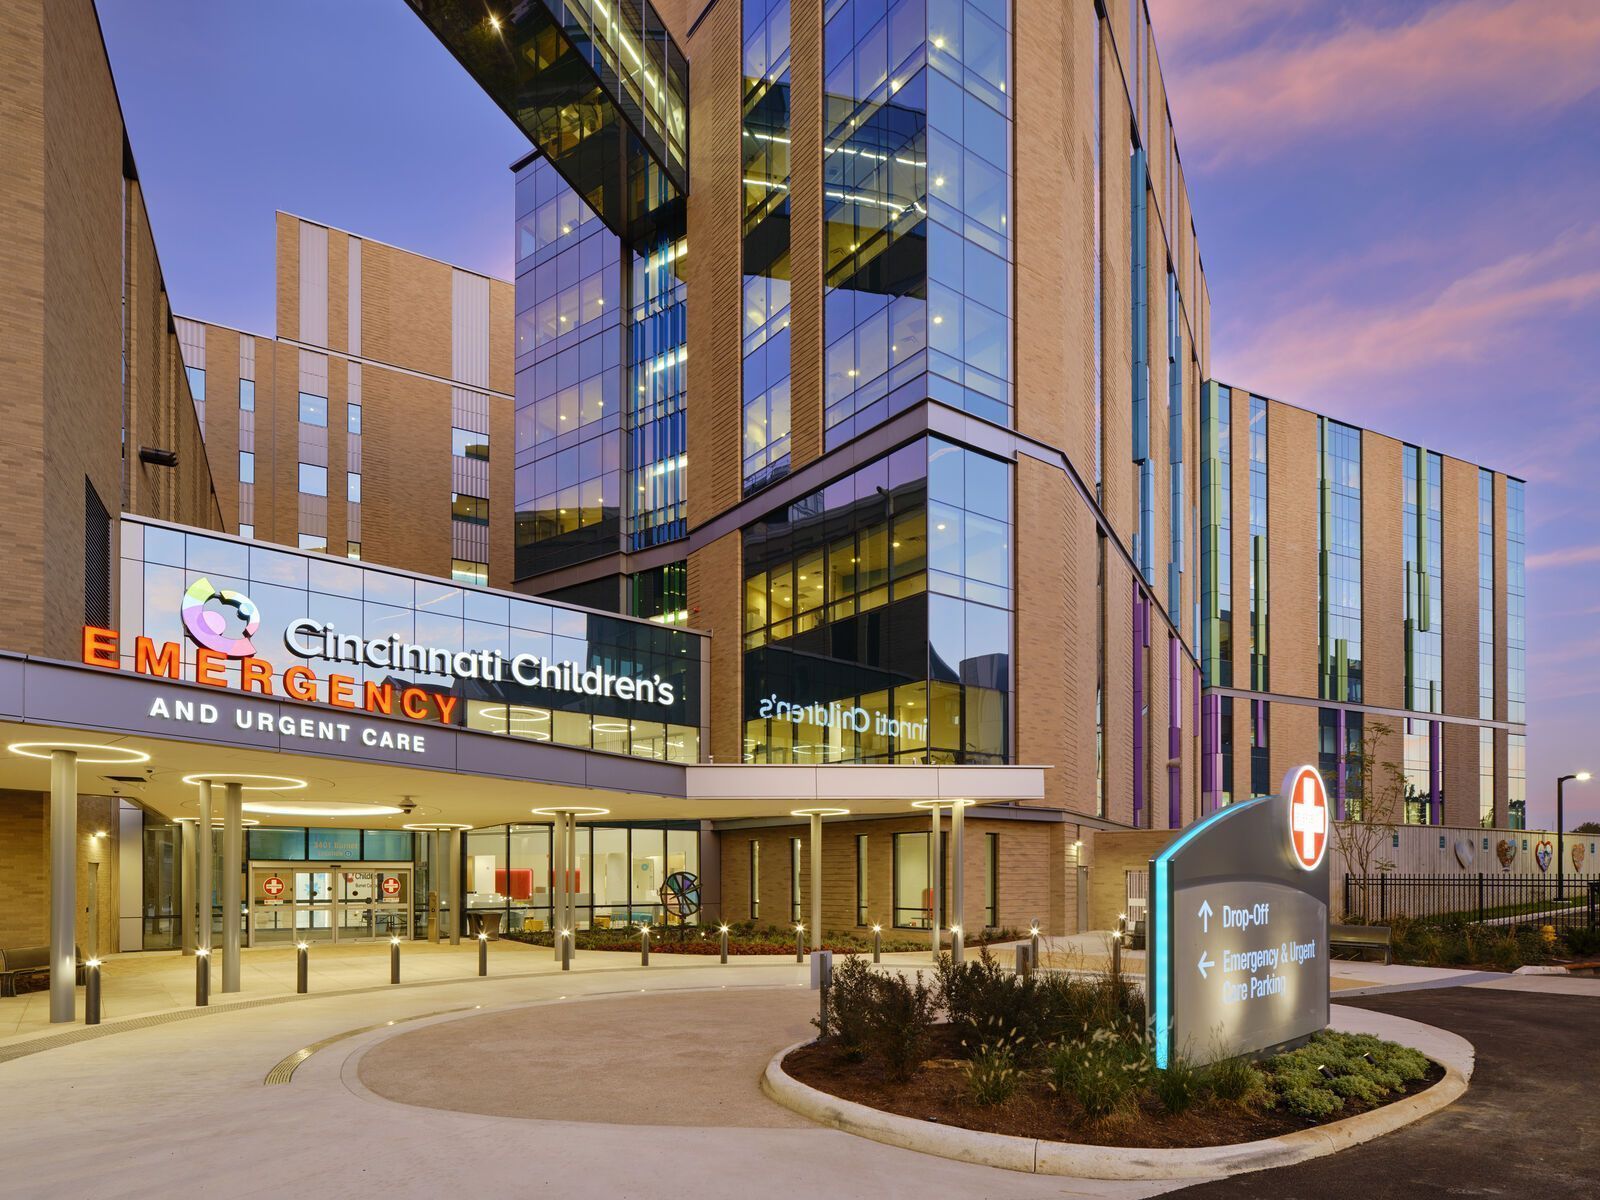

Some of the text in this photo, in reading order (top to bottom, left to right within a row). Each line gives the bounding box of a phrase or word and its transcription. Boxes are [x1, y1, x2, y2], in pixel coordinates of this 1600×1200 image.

[82, 625, 457, 724] EMERGENCY
[285, 617, 675, 705] Cincinnati Children's
[149, 697, 426, 753] AND URGENT CARE
[1223, 903, 1269, 931] Drop-Off
[1223, 939, 1315, 973] Emergency & Urgent
[1223, 973, 1287, 1004] Care Parking
